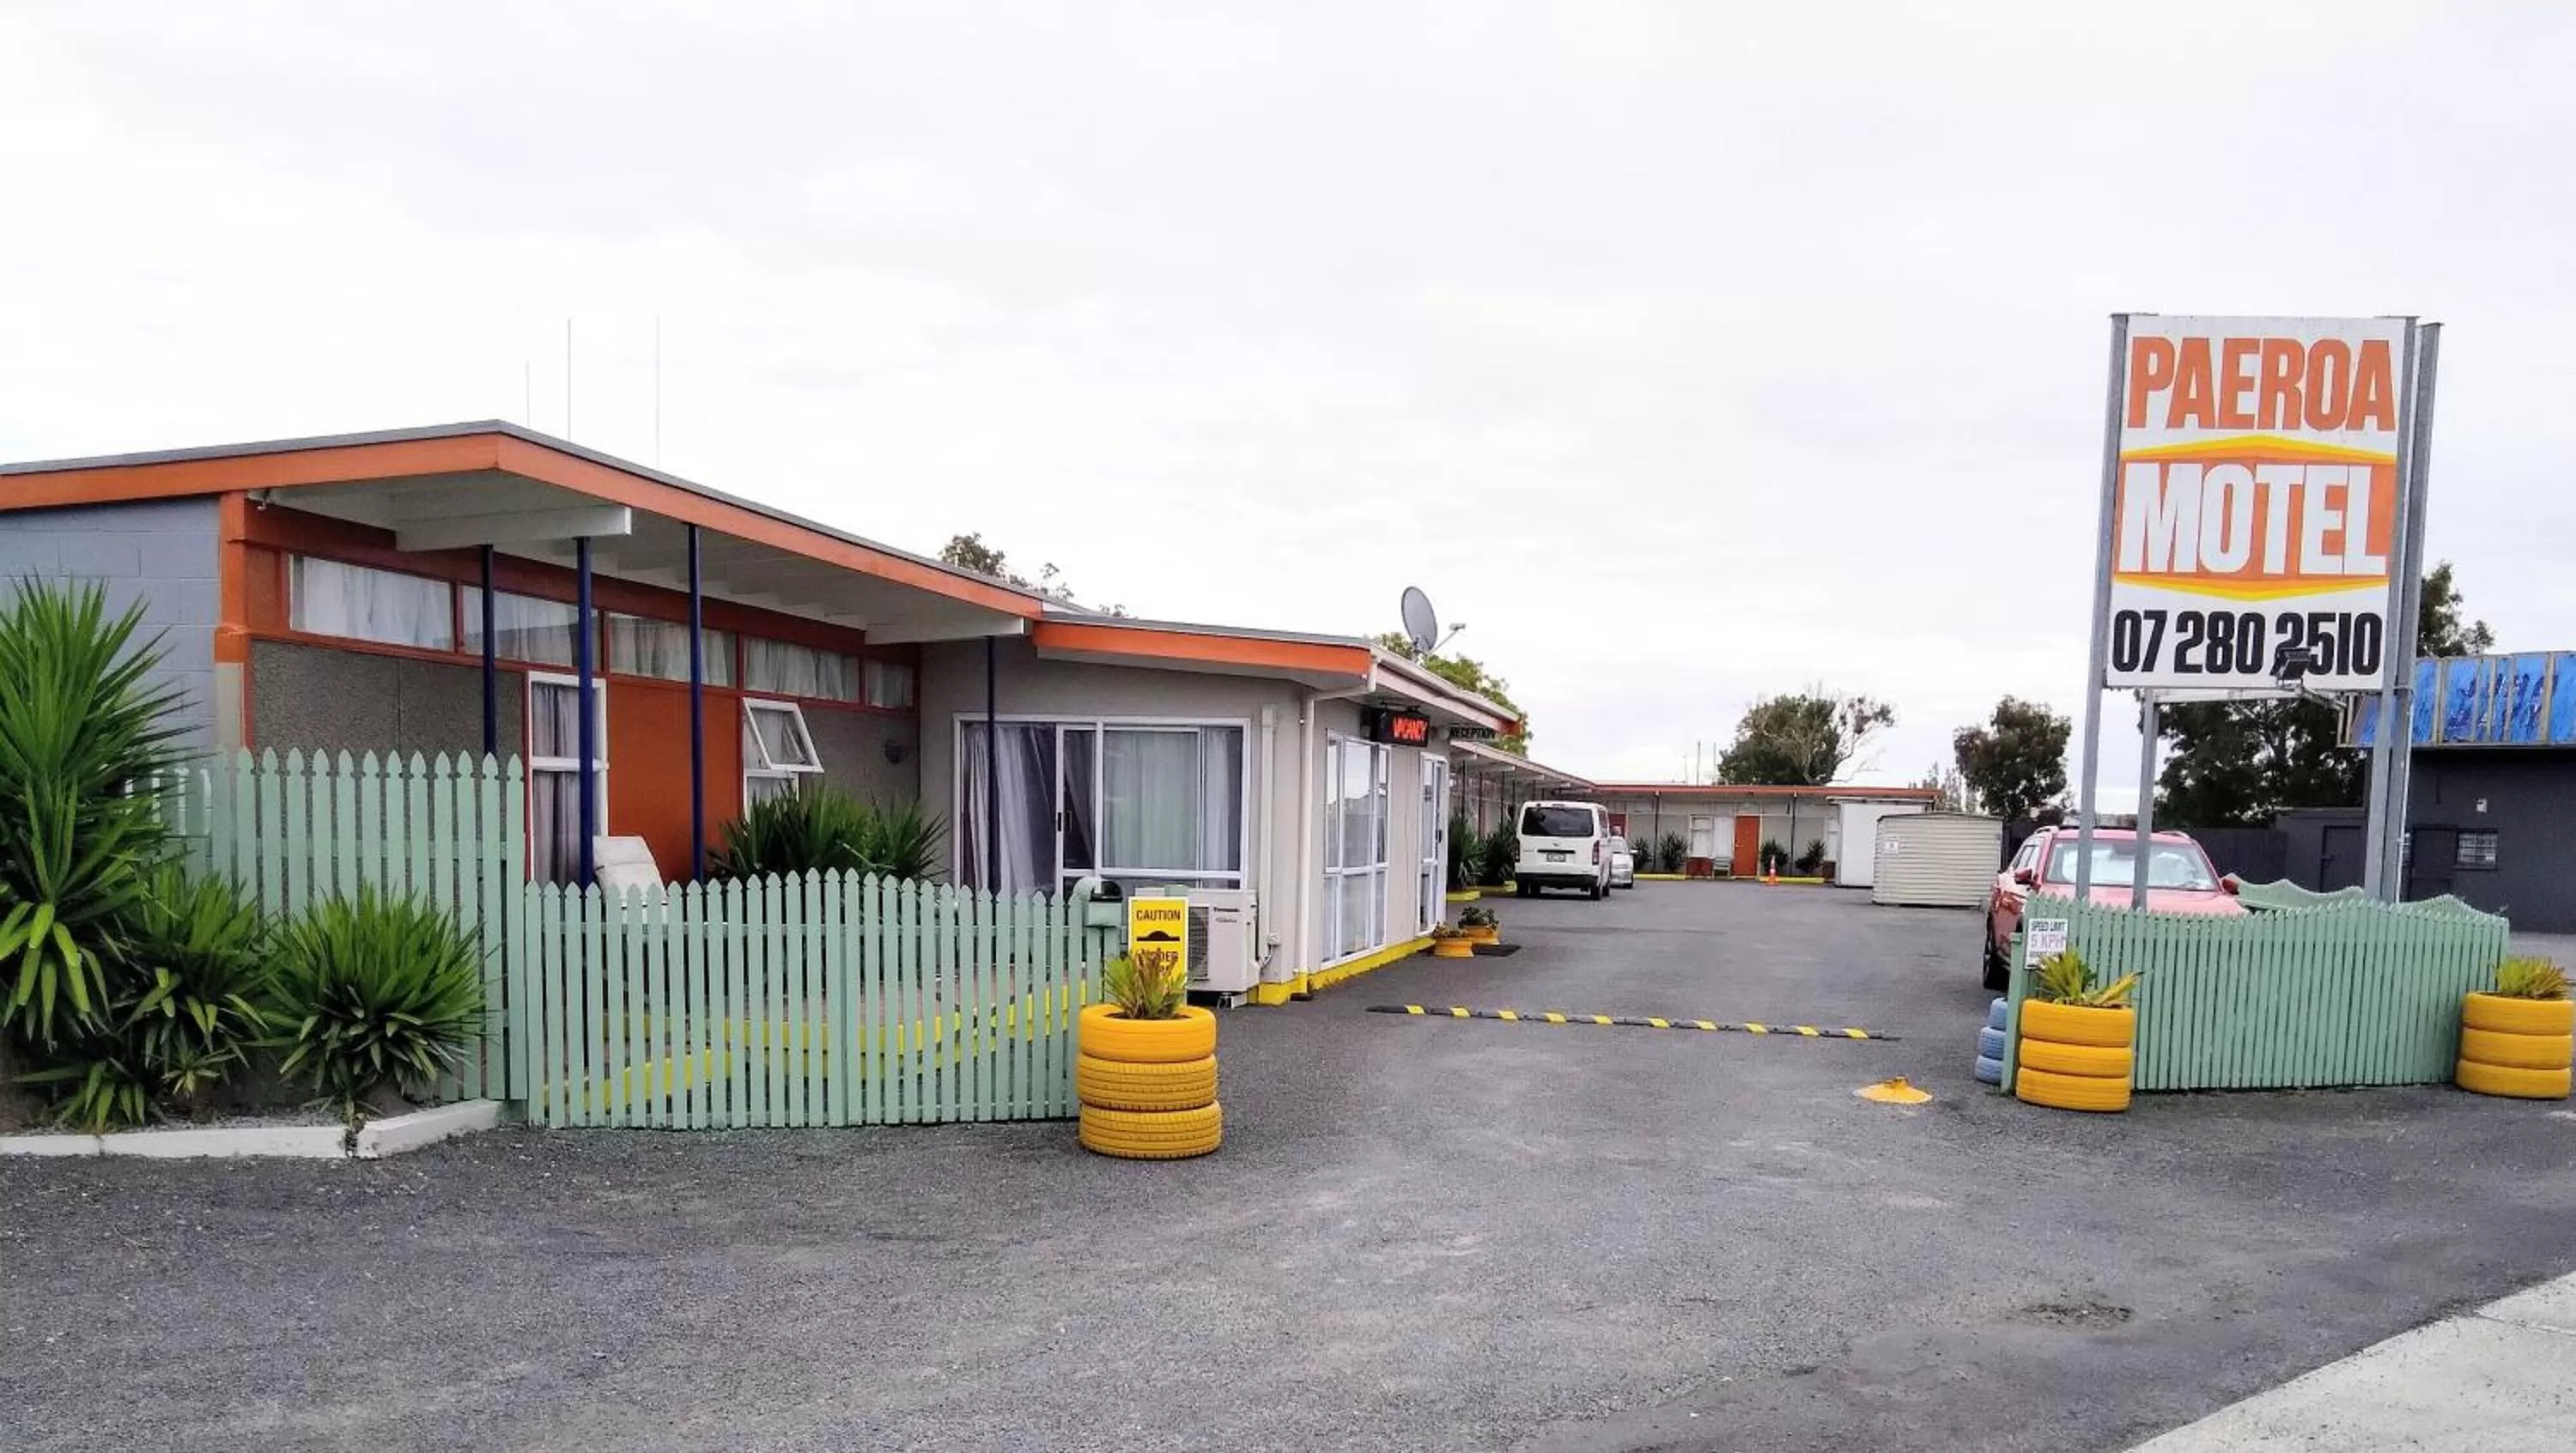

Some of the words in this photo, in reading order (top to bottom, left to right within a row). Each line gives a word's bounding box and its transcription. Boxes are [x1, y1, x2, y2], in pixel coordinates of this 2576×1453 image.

[2127, 337, 2396, 432] PAEROA
[2119, 462, 2386, 576] MOTEL
[2112, 609, 2168, 674] 07
[2173, 610, 2266, 675] 280
[2269, 611, 2383, 677] 2510
[1394, 717, 1428, 742] VACANCY
[1450, 726, 1496, 739] RECEPTION
[1136, 909, 1181, 921] CAUTION
[2031, 921, 2049, 932] SPEED
[2050, 921, 2065, 932] LIMIT
